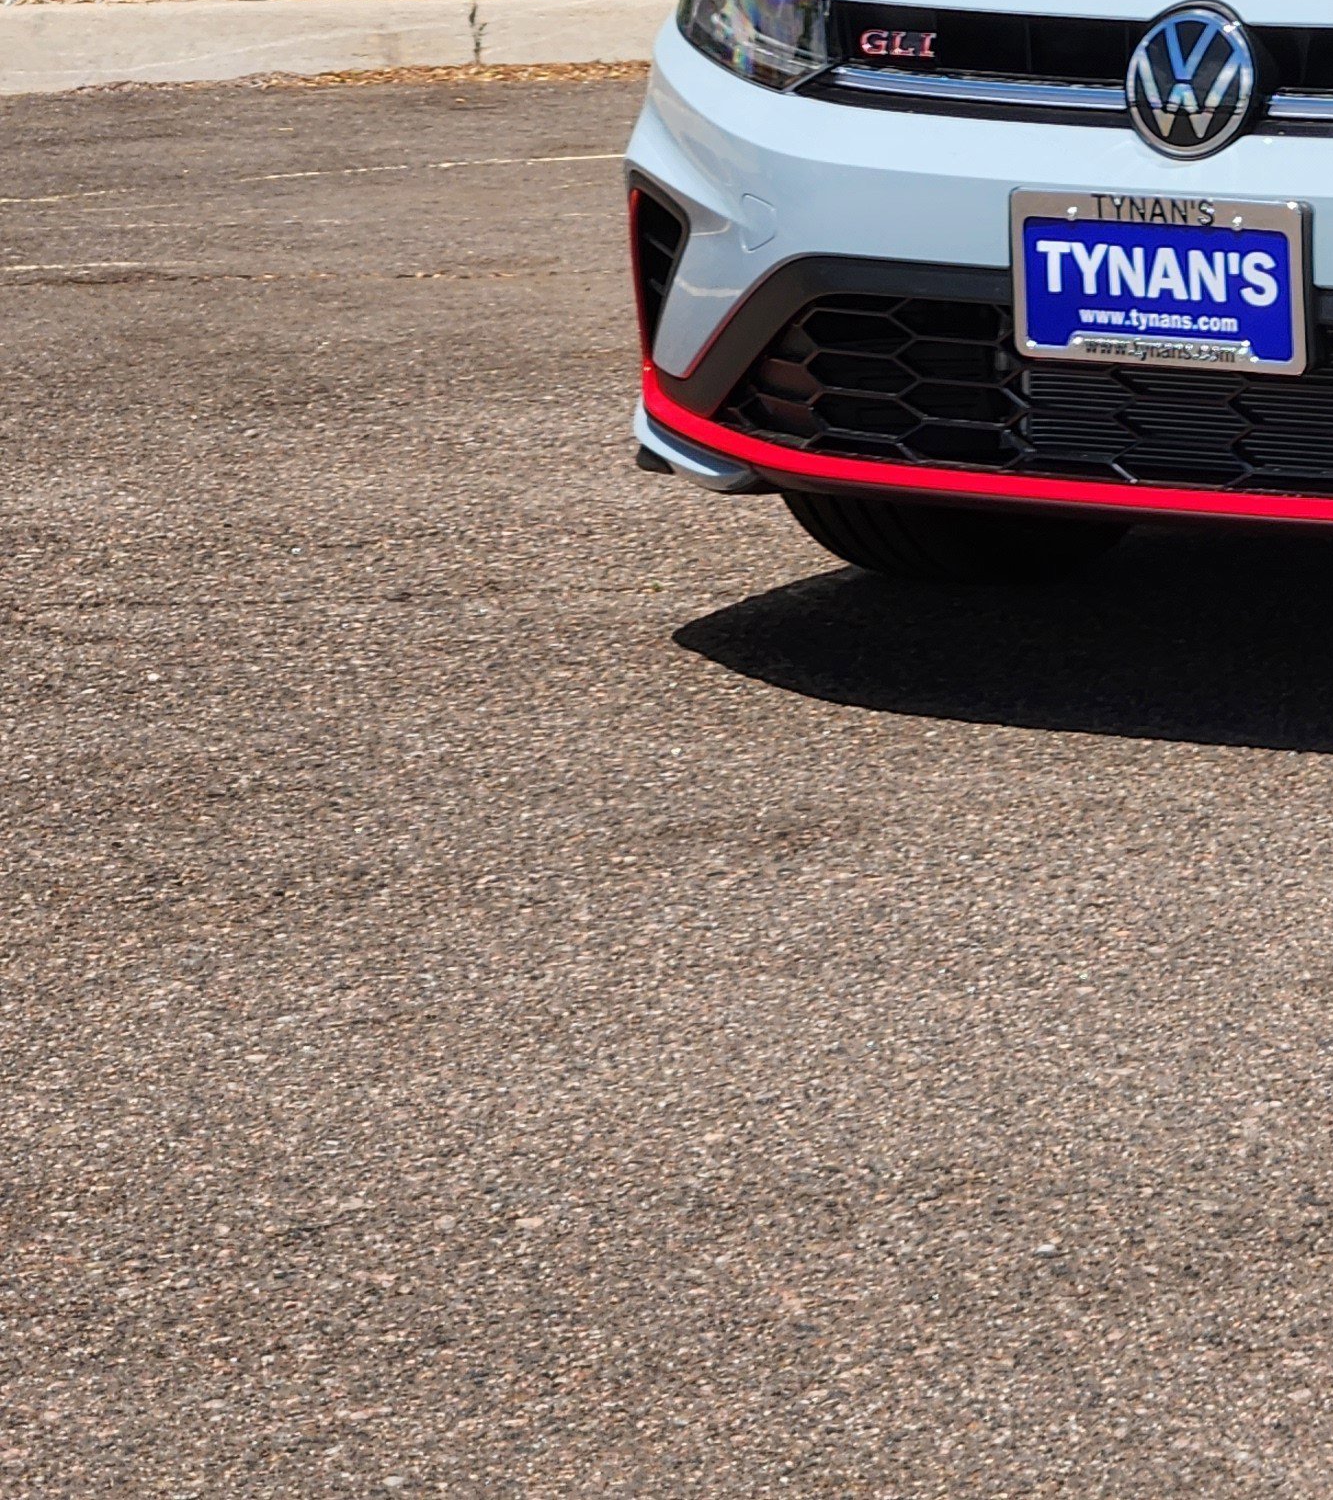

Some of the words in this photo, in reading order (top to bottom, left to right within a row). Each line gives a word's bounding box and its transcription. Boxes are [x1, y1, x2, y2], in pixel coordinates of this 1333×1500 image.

[860, 29, 937, 58] GLI
[1090, 193, 1215, 226] TYNAN'S
[1036, 239, 1278, 307] TYNAN'S
[1078, 308, 1239, 332] www.tynans.com
